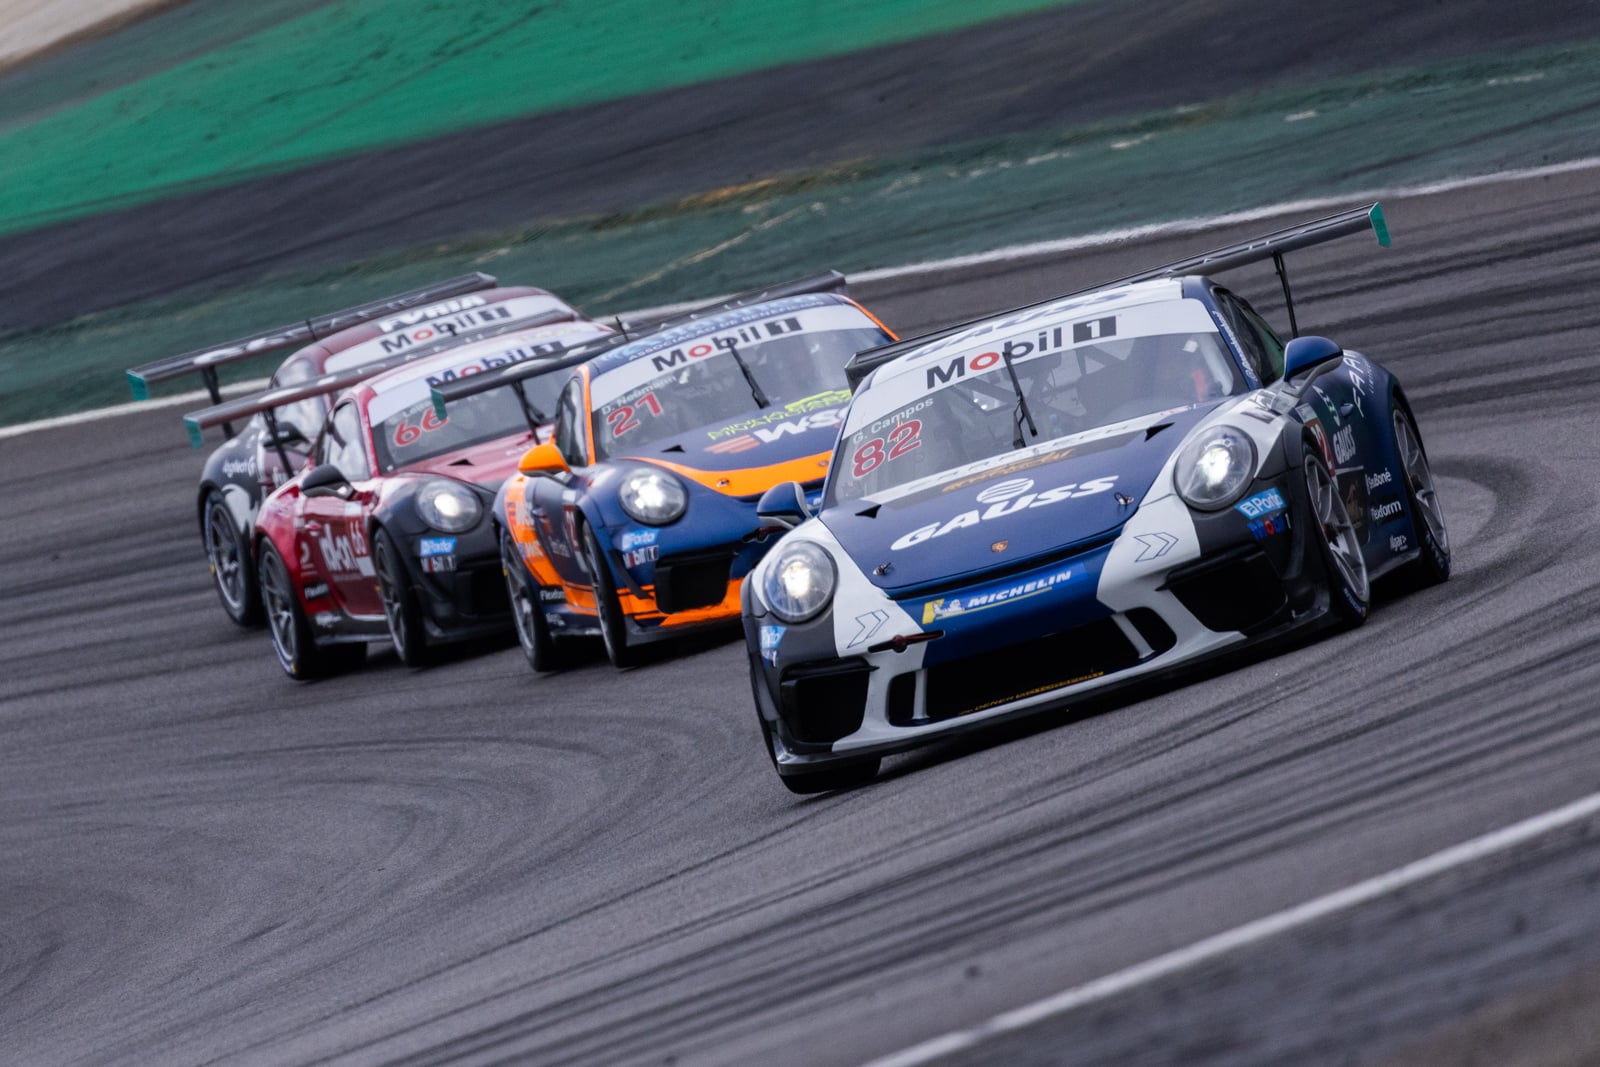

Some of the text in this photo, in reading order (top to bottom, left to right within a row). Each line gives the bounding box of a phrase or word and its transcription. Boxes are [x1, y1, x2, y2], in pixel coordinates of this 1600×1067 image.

[380, 313, 478, 354] Mobil
[652, 326, 761, 372] Mobil
[926, 327, 1062, 390] Mobil
[393, 407, 449, 447] 66
[606, 391, 664, 439] 21
[853, 431, 868, 445] G.
[870, 397, 935, 434] Campos
[852, 419, 923, 479] 82
[889, 475, 1120, 551] GAUSS
[967, 570, 1072, 608] MICHELIN
